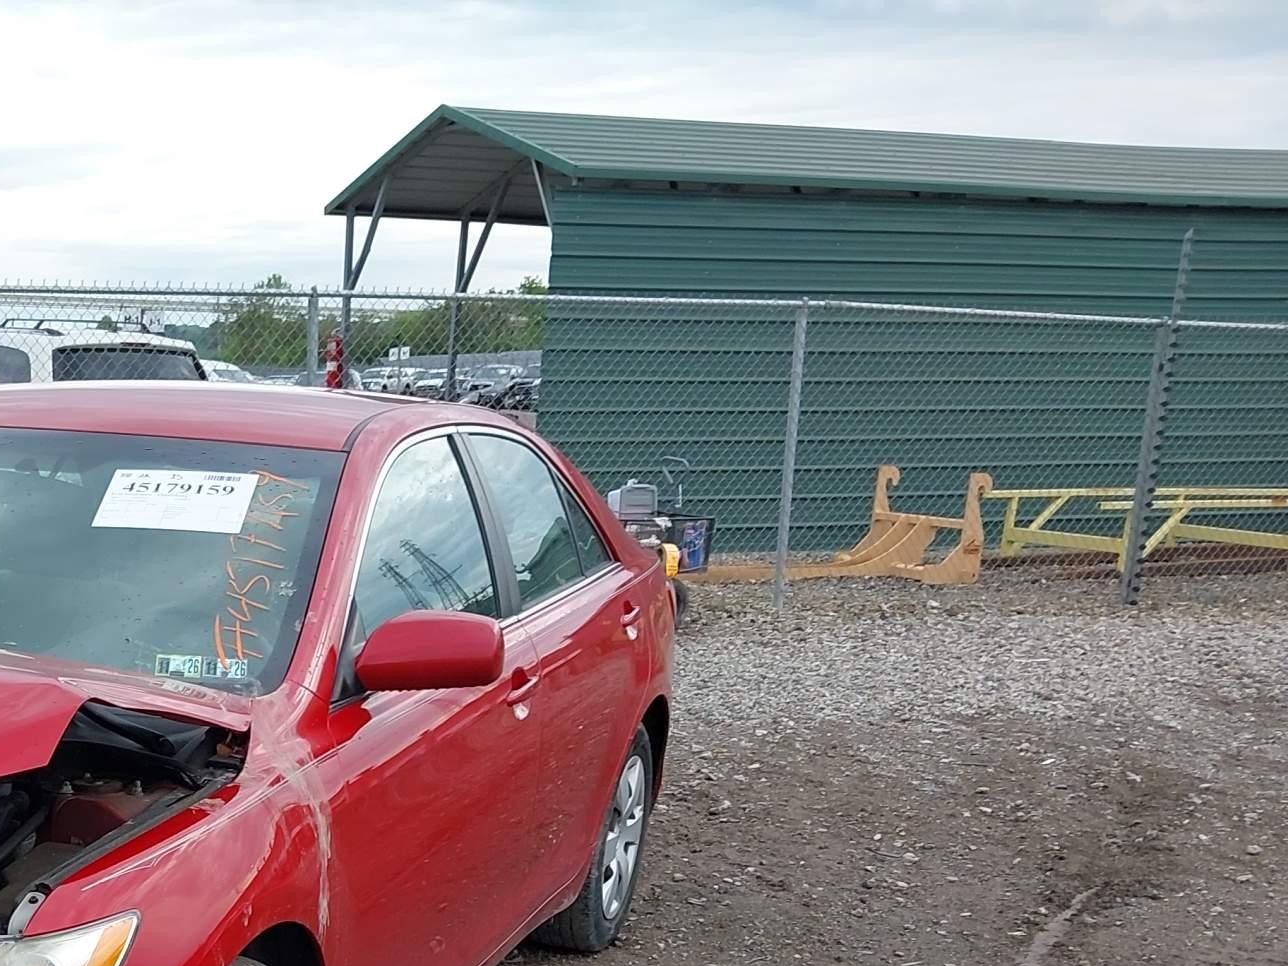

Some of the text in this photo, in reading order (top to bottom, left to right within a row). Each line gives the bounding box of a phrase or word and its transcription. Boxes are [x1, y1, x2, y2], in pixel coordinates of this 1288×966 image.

[122, 482, 235, 496] 45179159
[187, 659, 199, 674] 26
[234, 661, 246, 677] 26
